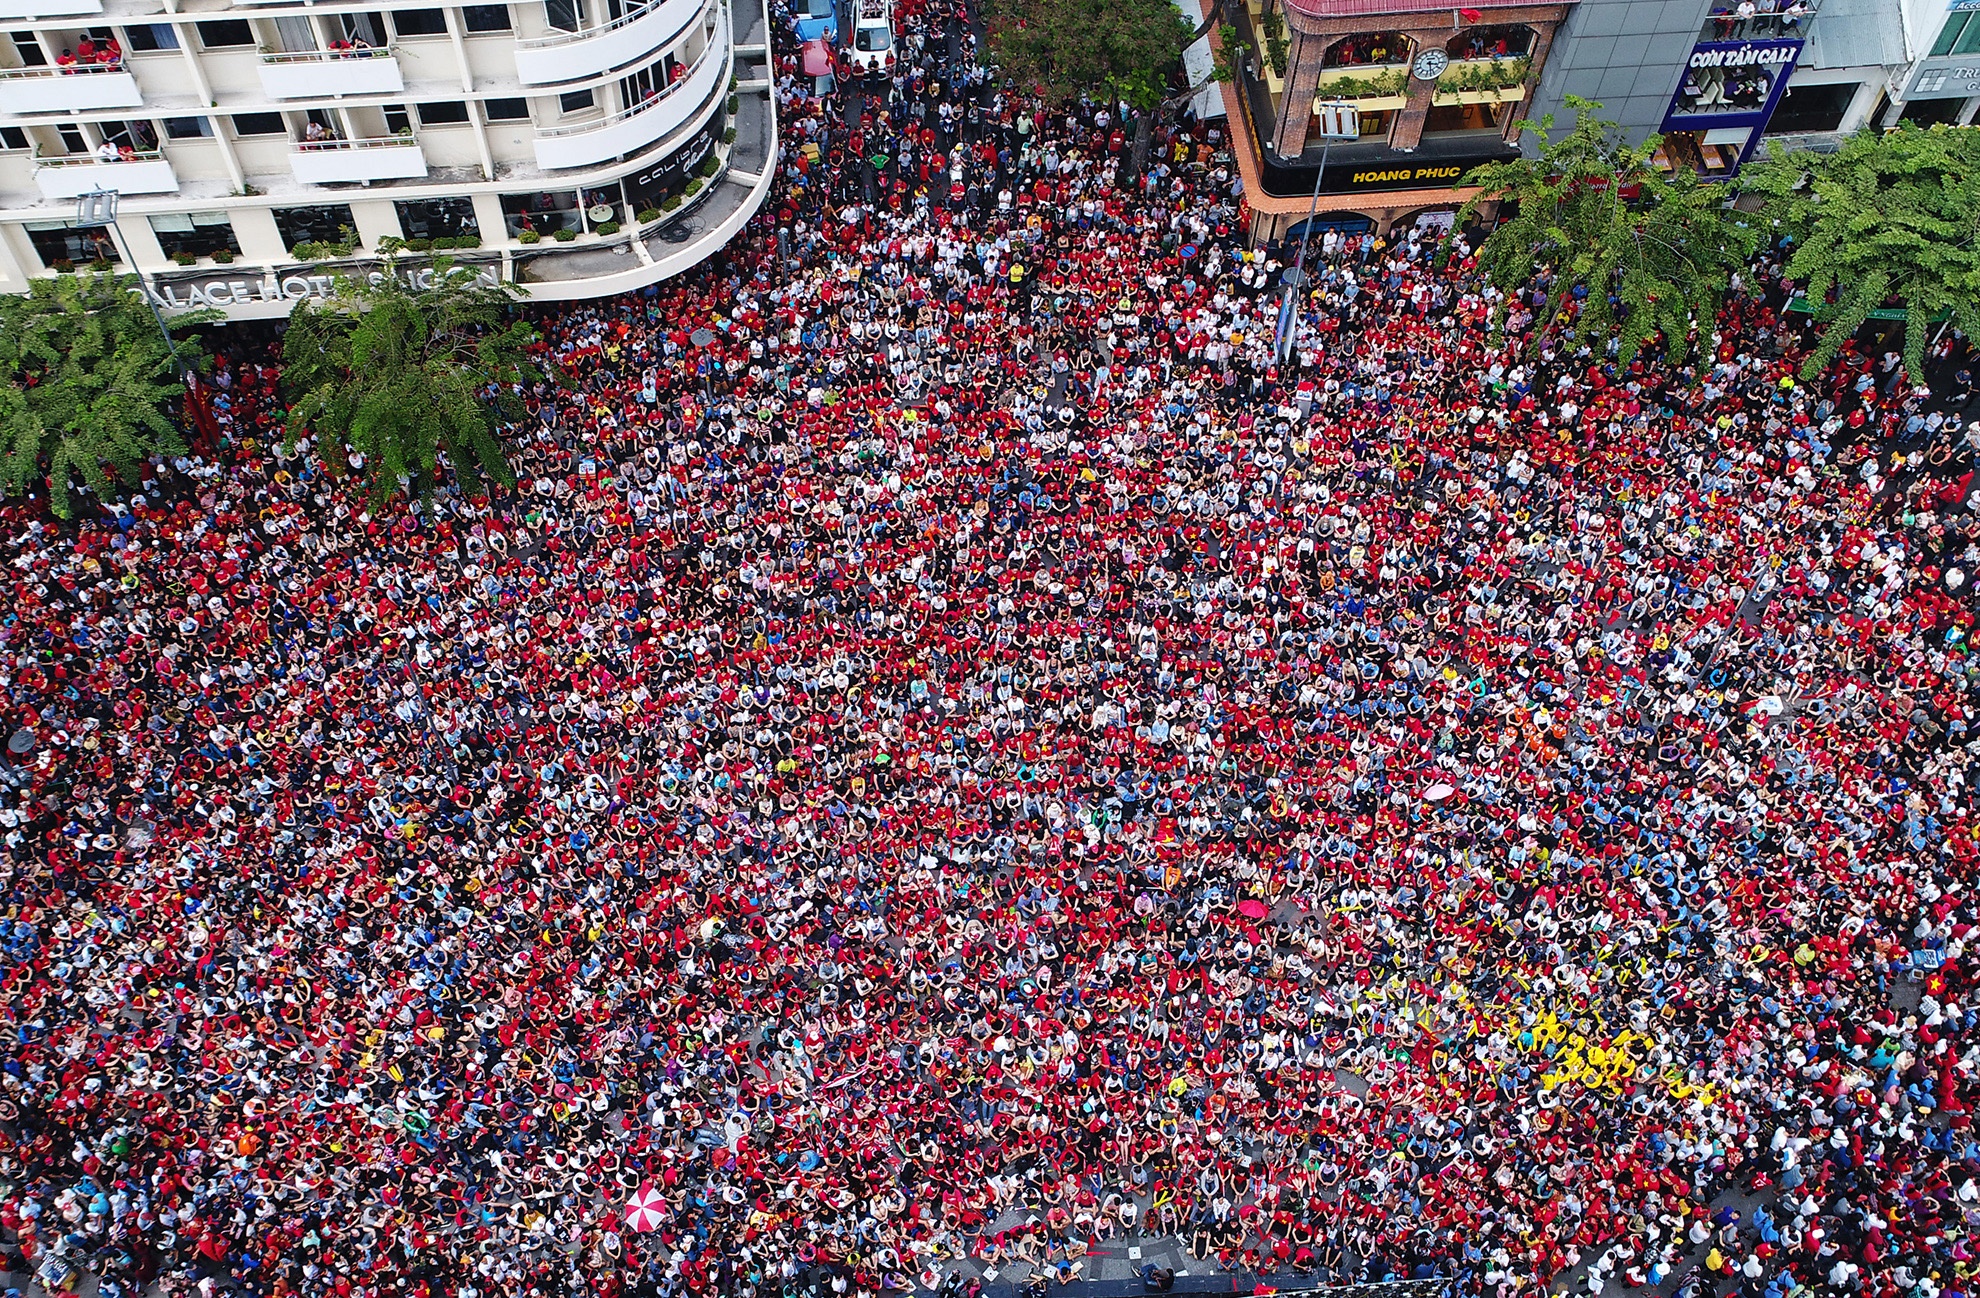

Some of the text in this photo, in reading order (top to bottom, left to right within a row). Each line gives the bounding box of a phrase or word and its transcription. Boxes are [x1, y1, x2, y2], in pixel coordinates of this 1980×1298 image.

[1758, 46, 1797, 64] CALI
[1966, 81, 1980, 90] G
[1352, 166, 1461, 183] HOANG PHUC
[255, 275, 350, 303] HOT
[367, 265, 500, 293] SIGN
